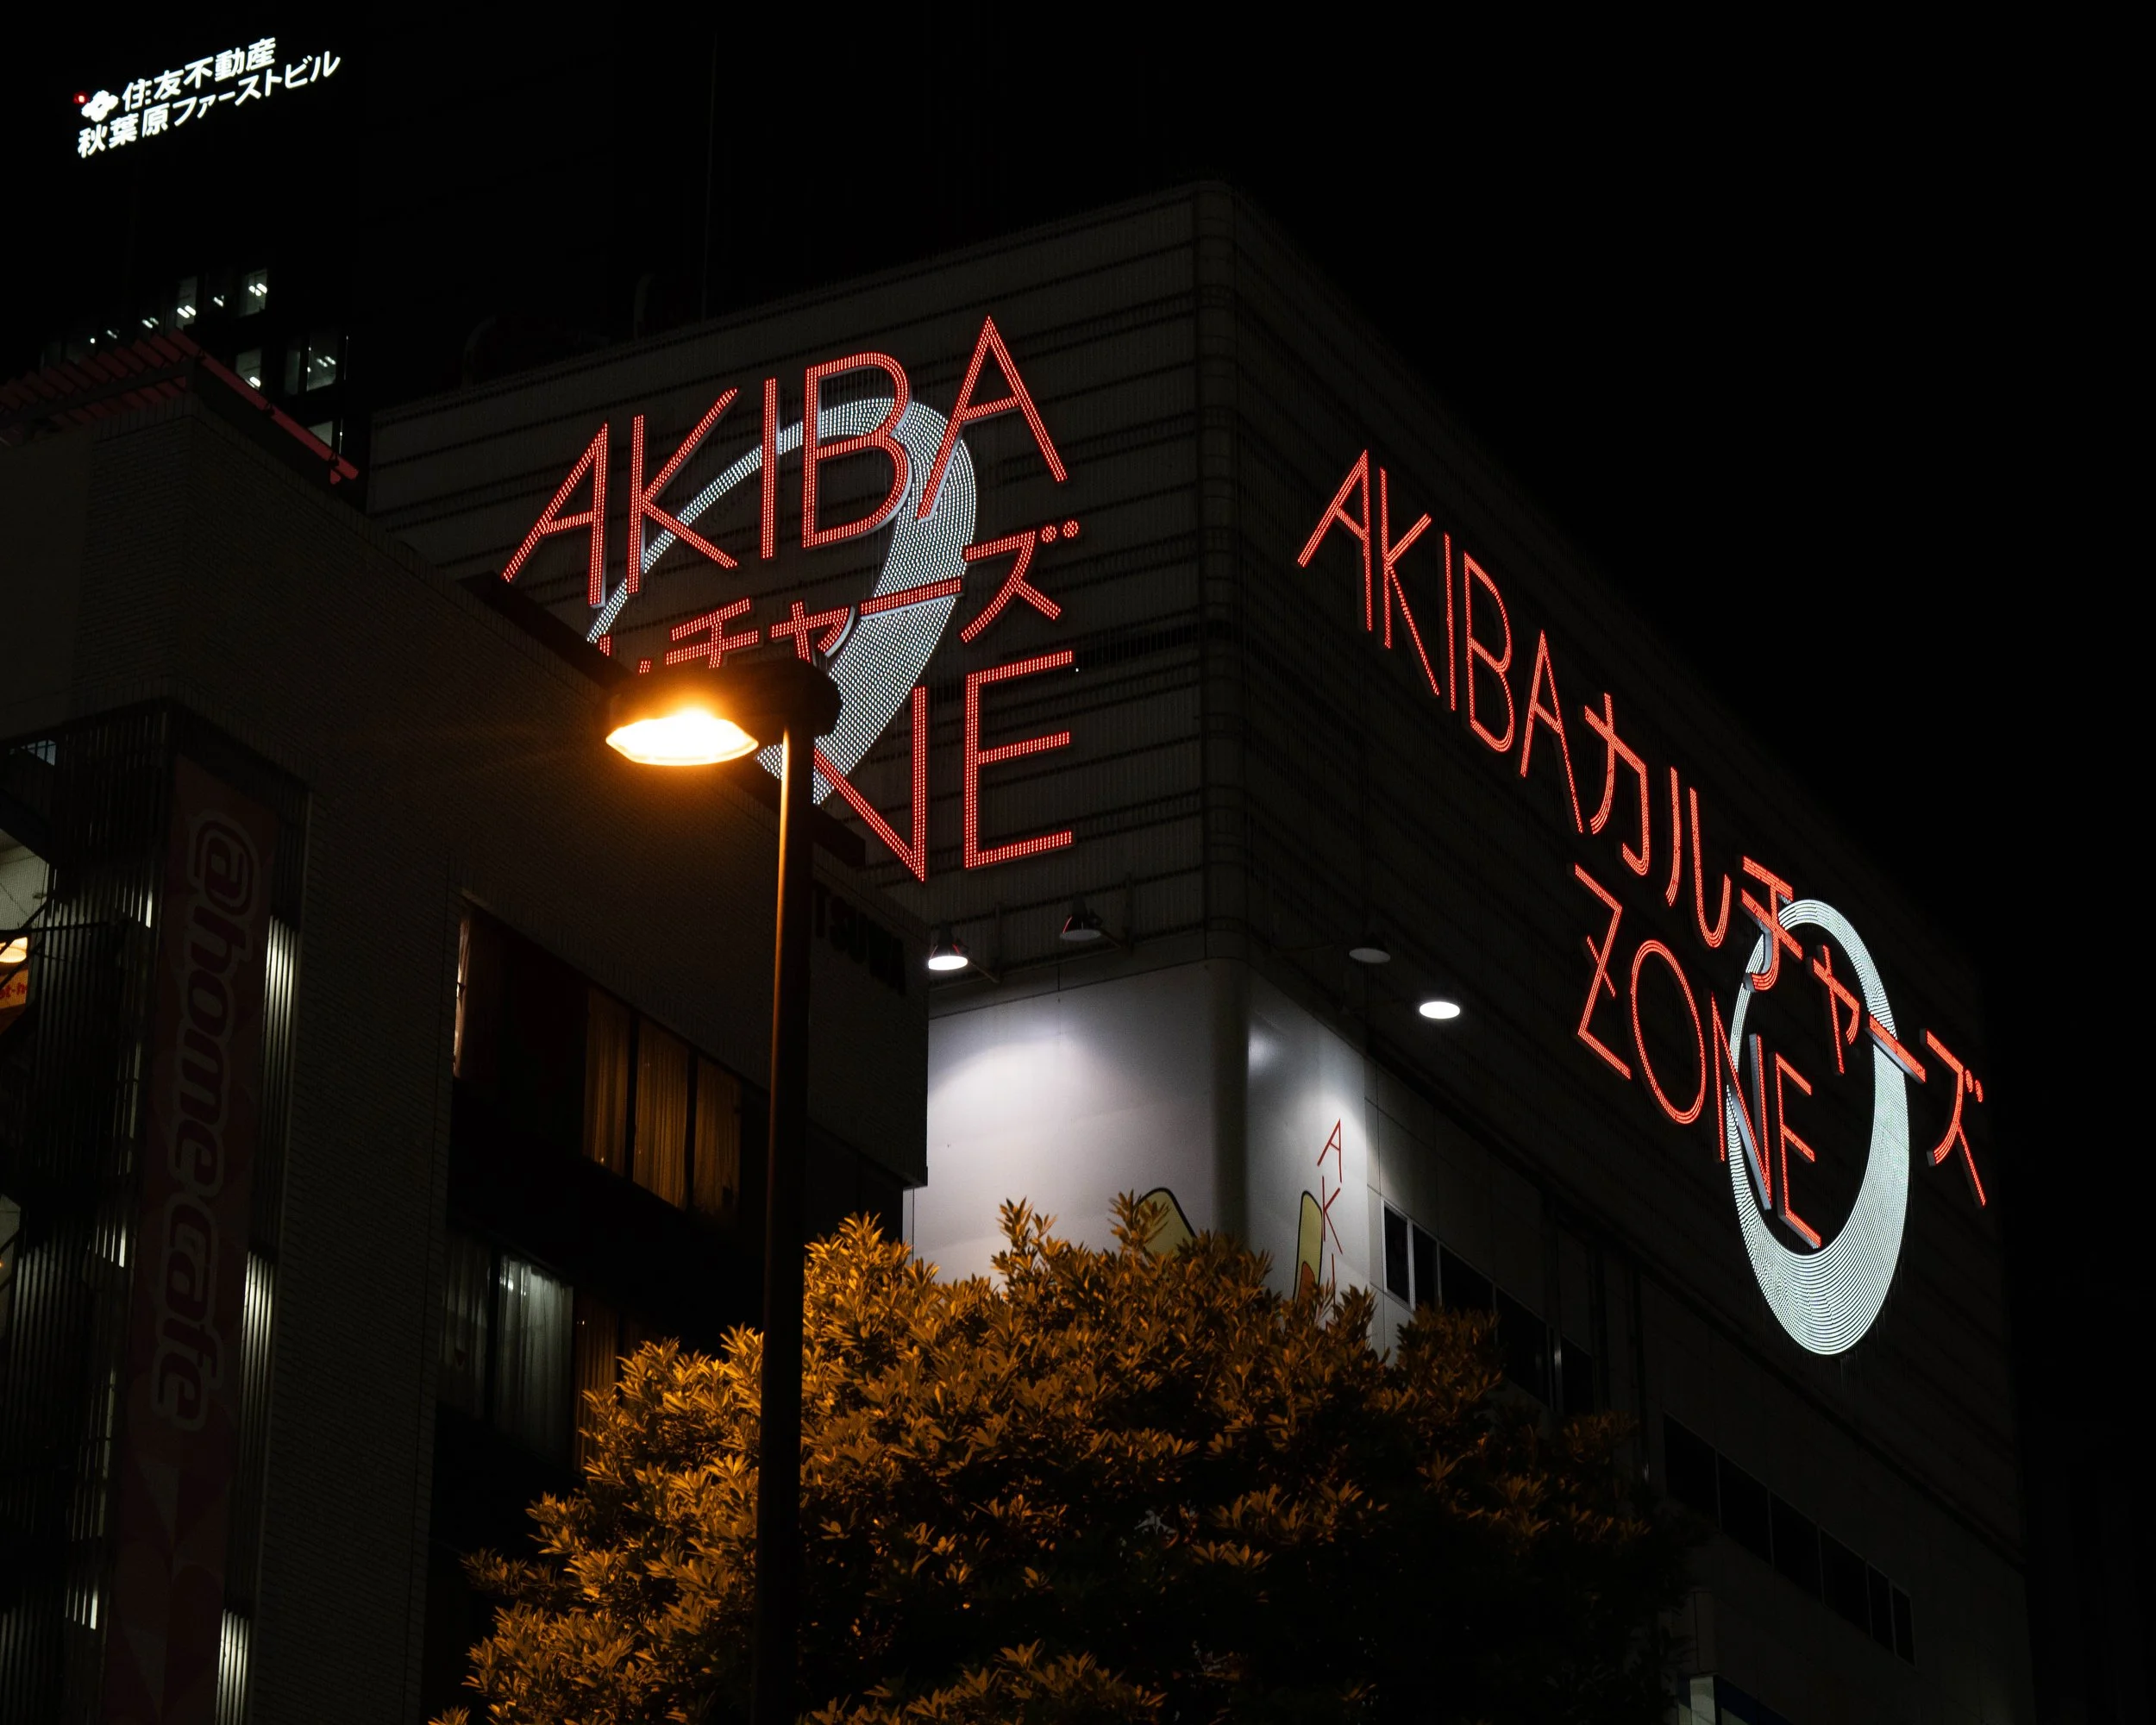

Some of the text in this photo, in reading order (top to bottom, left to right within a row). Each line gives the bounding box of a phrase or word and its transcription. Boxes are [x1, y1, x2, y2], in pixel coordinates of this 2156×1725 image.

[78, 51, 341, 158] 秋葉原ファーストビル
[122, 37, 276, 111] 住友不動産
[501, 315, 1069, 606] AKIBA
[599, 519, 1080, 671] チャーズ
[1575, 863, 1821, 1249] ZONE
